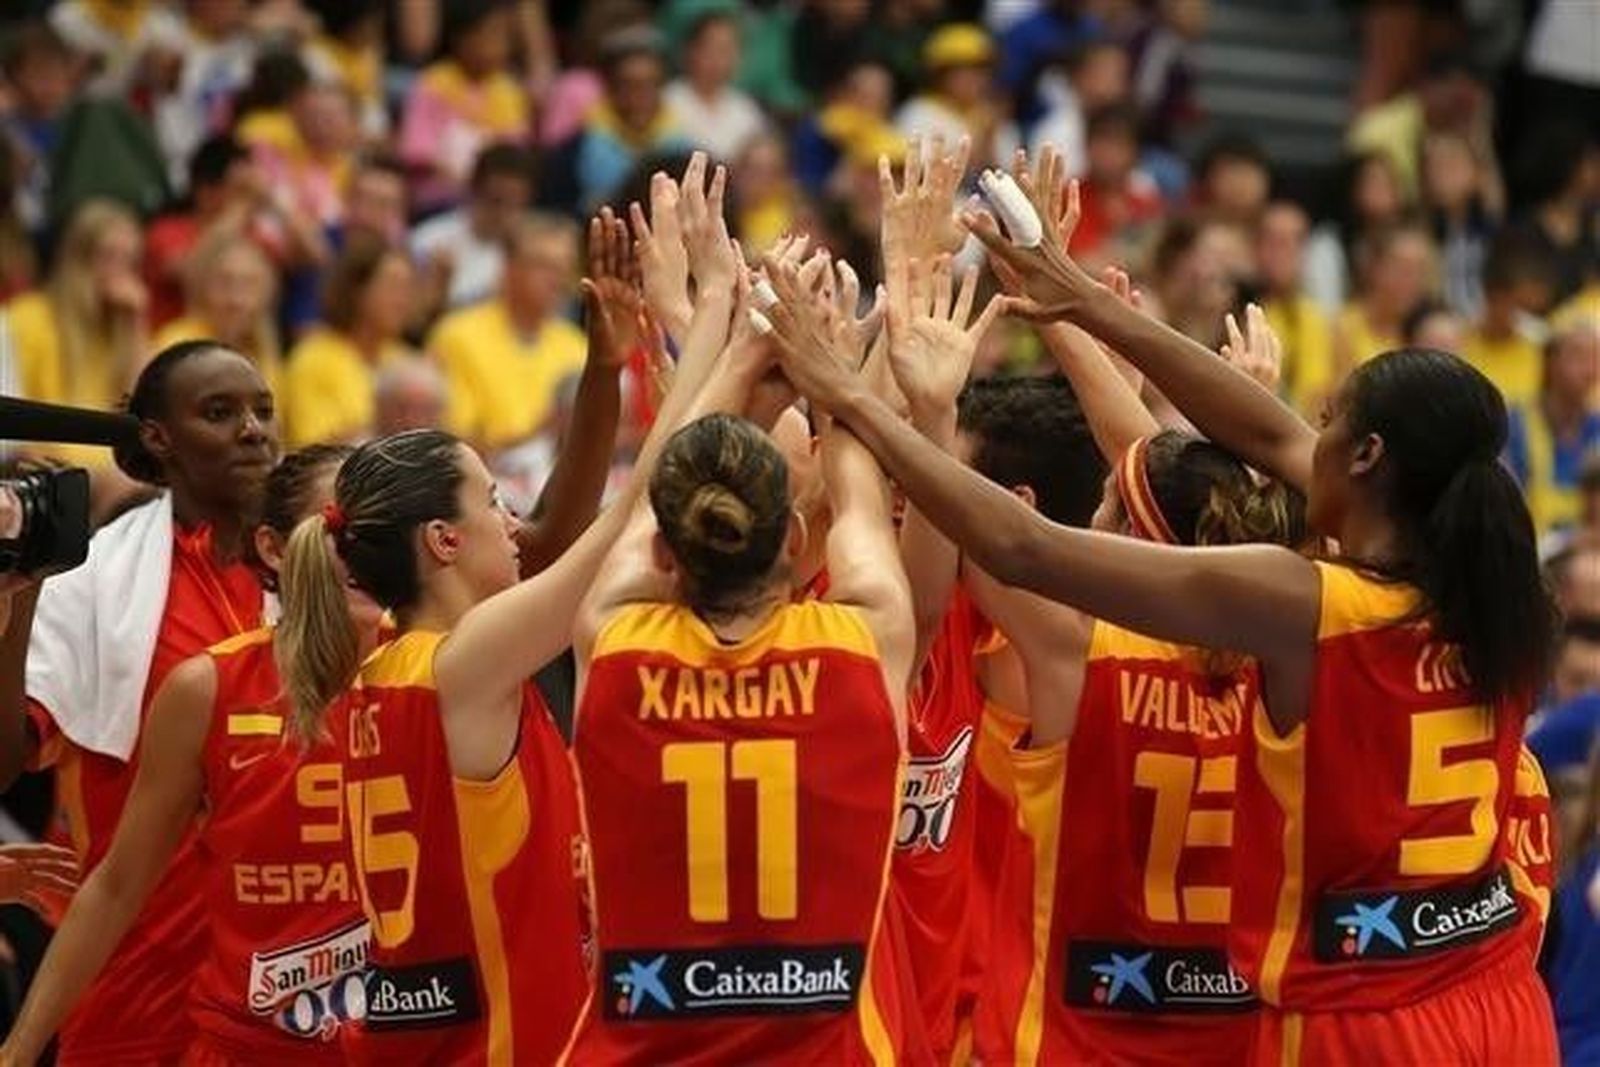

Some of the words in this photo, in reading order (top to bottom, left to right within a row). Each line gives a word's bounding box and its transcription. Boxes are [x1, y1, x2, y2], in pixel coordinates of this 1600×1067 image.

[637, 658, 820, 721] XARGAY
[662, 739, 797, 922] 11
[1399, 706, 1500, 876] 5
[684, 958, 852, 998] CaixaBank
